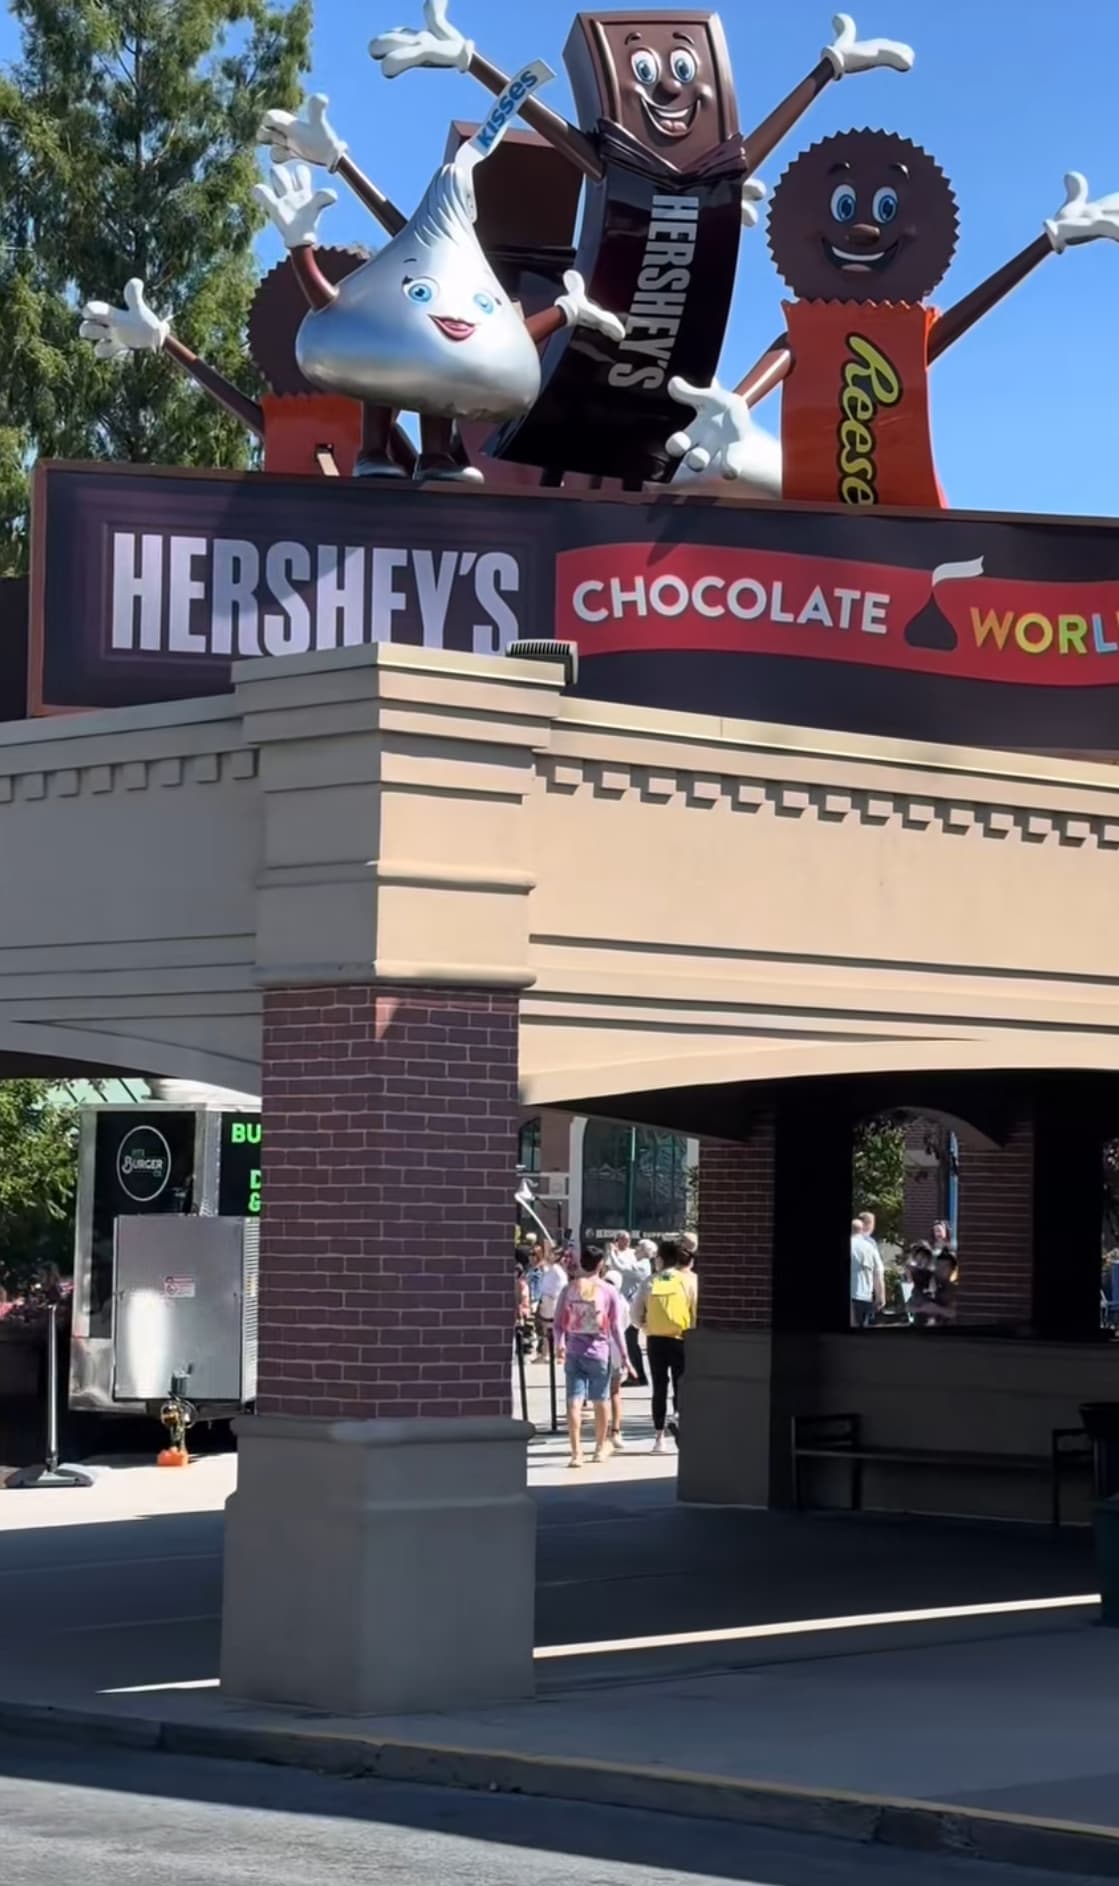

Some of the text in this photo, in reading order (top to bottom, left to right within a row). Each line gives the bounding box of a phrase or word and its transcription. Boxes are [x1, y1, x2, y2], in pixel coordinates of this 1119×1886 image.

[608, 195, 699, 390] HERSHEY'S
[112, 532, 520, 658] HERSHEY'S
[572, 574, 1119, 654] CHOCOLATE WORL
